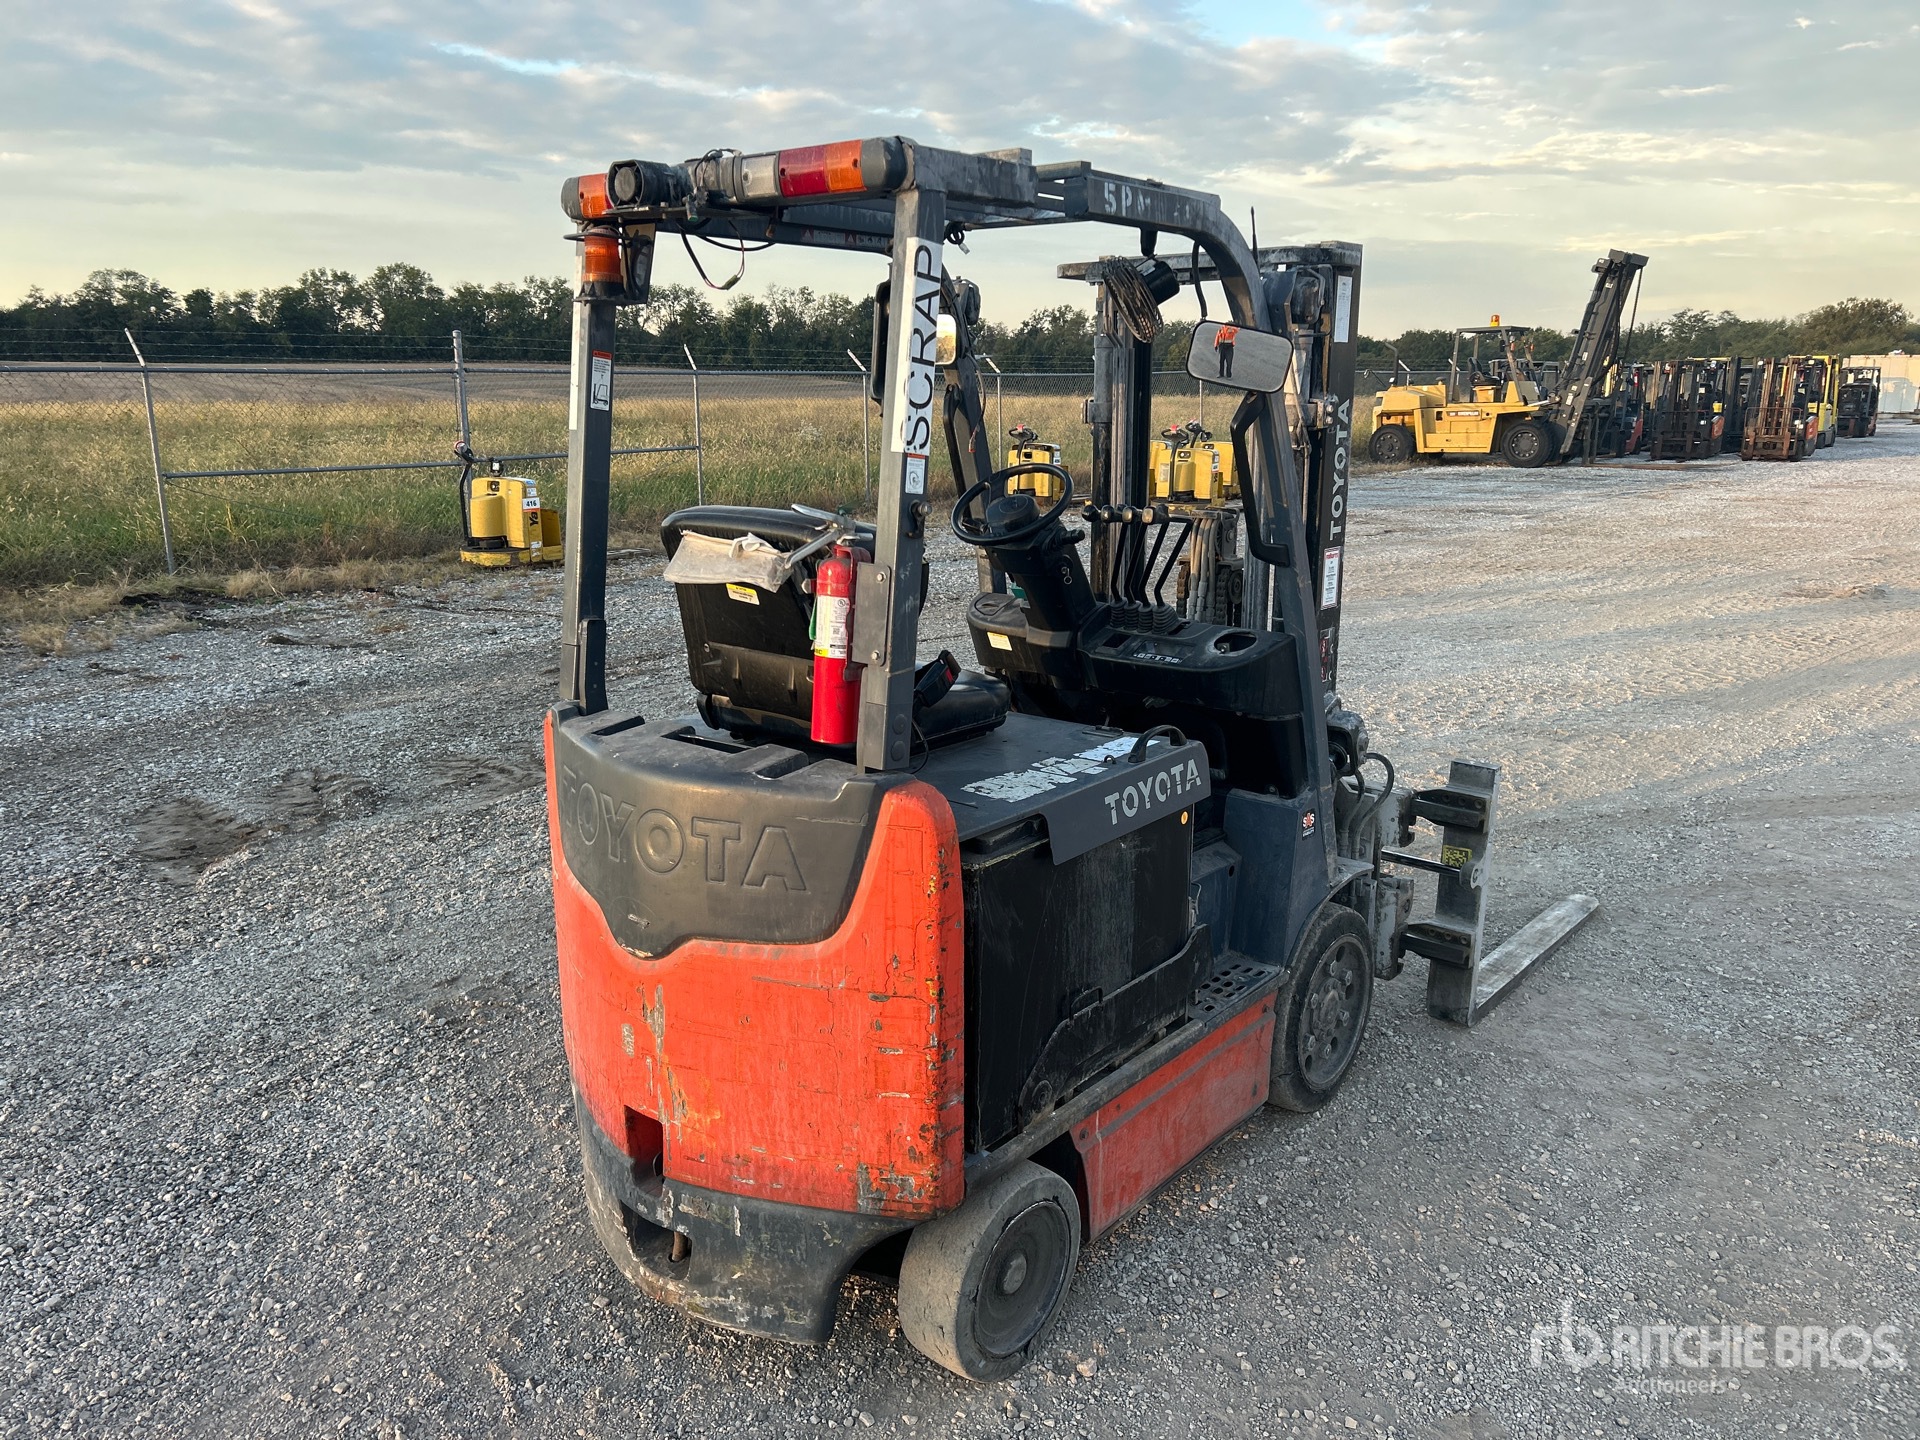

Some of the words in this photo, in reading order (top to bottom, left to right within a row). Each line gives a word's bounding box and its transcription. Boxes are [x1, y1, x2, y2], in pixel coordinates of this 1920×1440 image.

[901, 244, 941, 451] SCRAP
[525, 499, 537, 507] 416
[1330, 399, 1350, 541] TOYOTA
[562, 764, 807, 892] TOYOTA
[1104, 758, 1202, 825] TOYOTA
